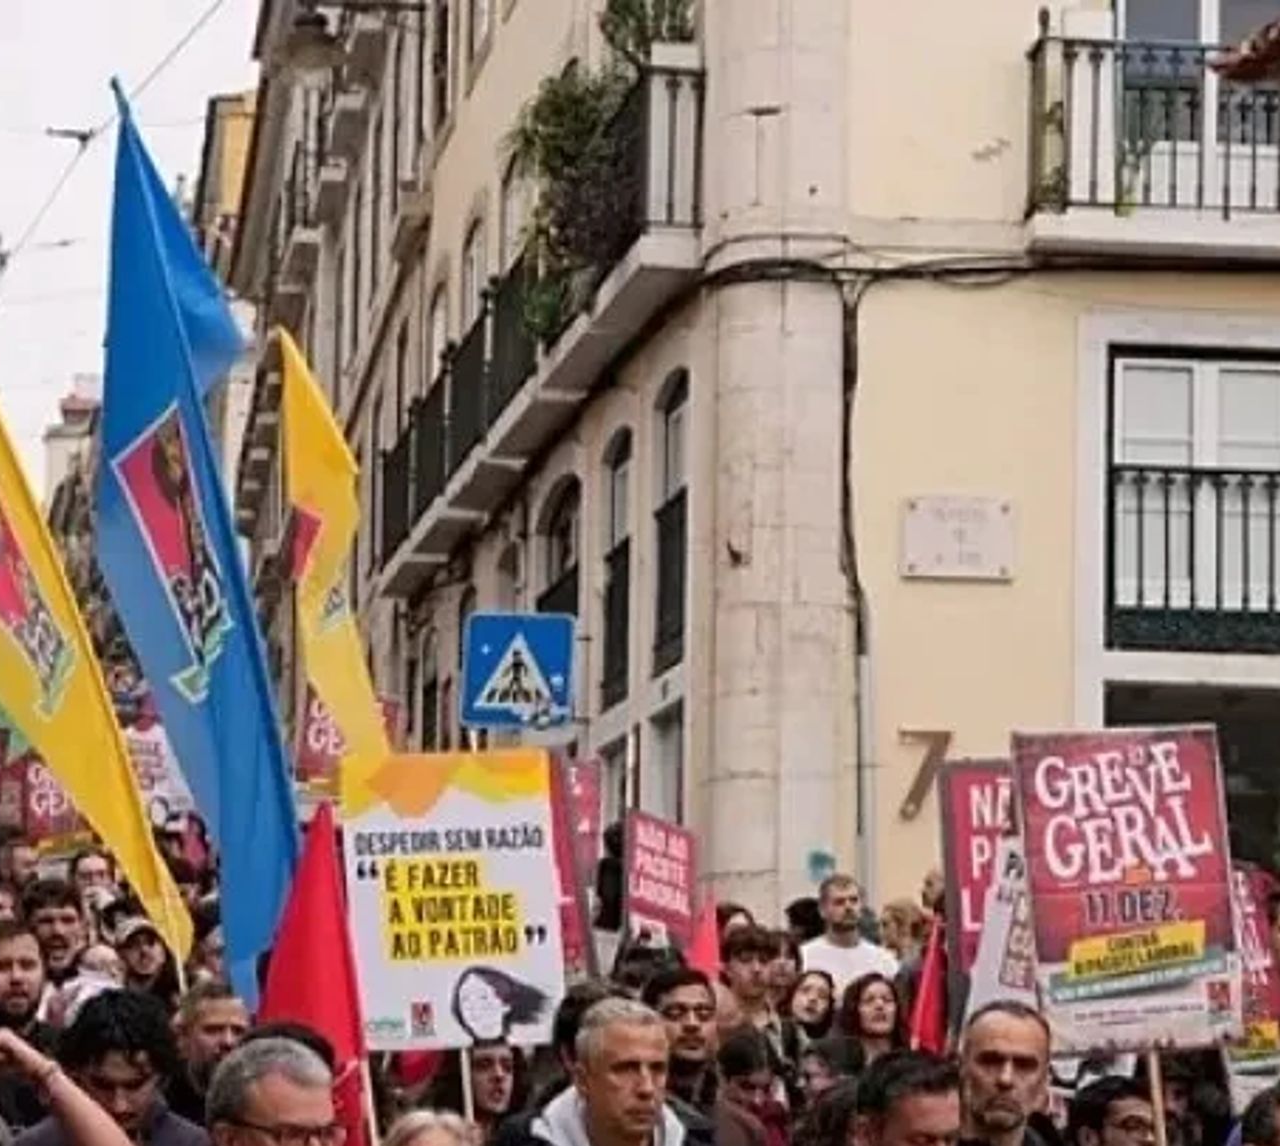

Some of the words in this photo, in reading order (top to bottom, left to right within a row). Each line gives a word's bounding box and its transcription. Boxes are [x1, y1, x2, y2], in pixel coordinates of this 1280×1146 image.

[1035, 742, 1191, 817] GREVE
[354, 832, 441, 856] DESPEDIR
[444, 828, 483, 851] SEM
[485, 822, 544, 849] RAZÃO
[1045, 797, 1212, 883] GERAL
[407, 860, 479, 891] FAZER
[389, 899, 403, 925] A
[411, 894, 515, 924] VONTADE
[392, 931, 421, 960] AO
